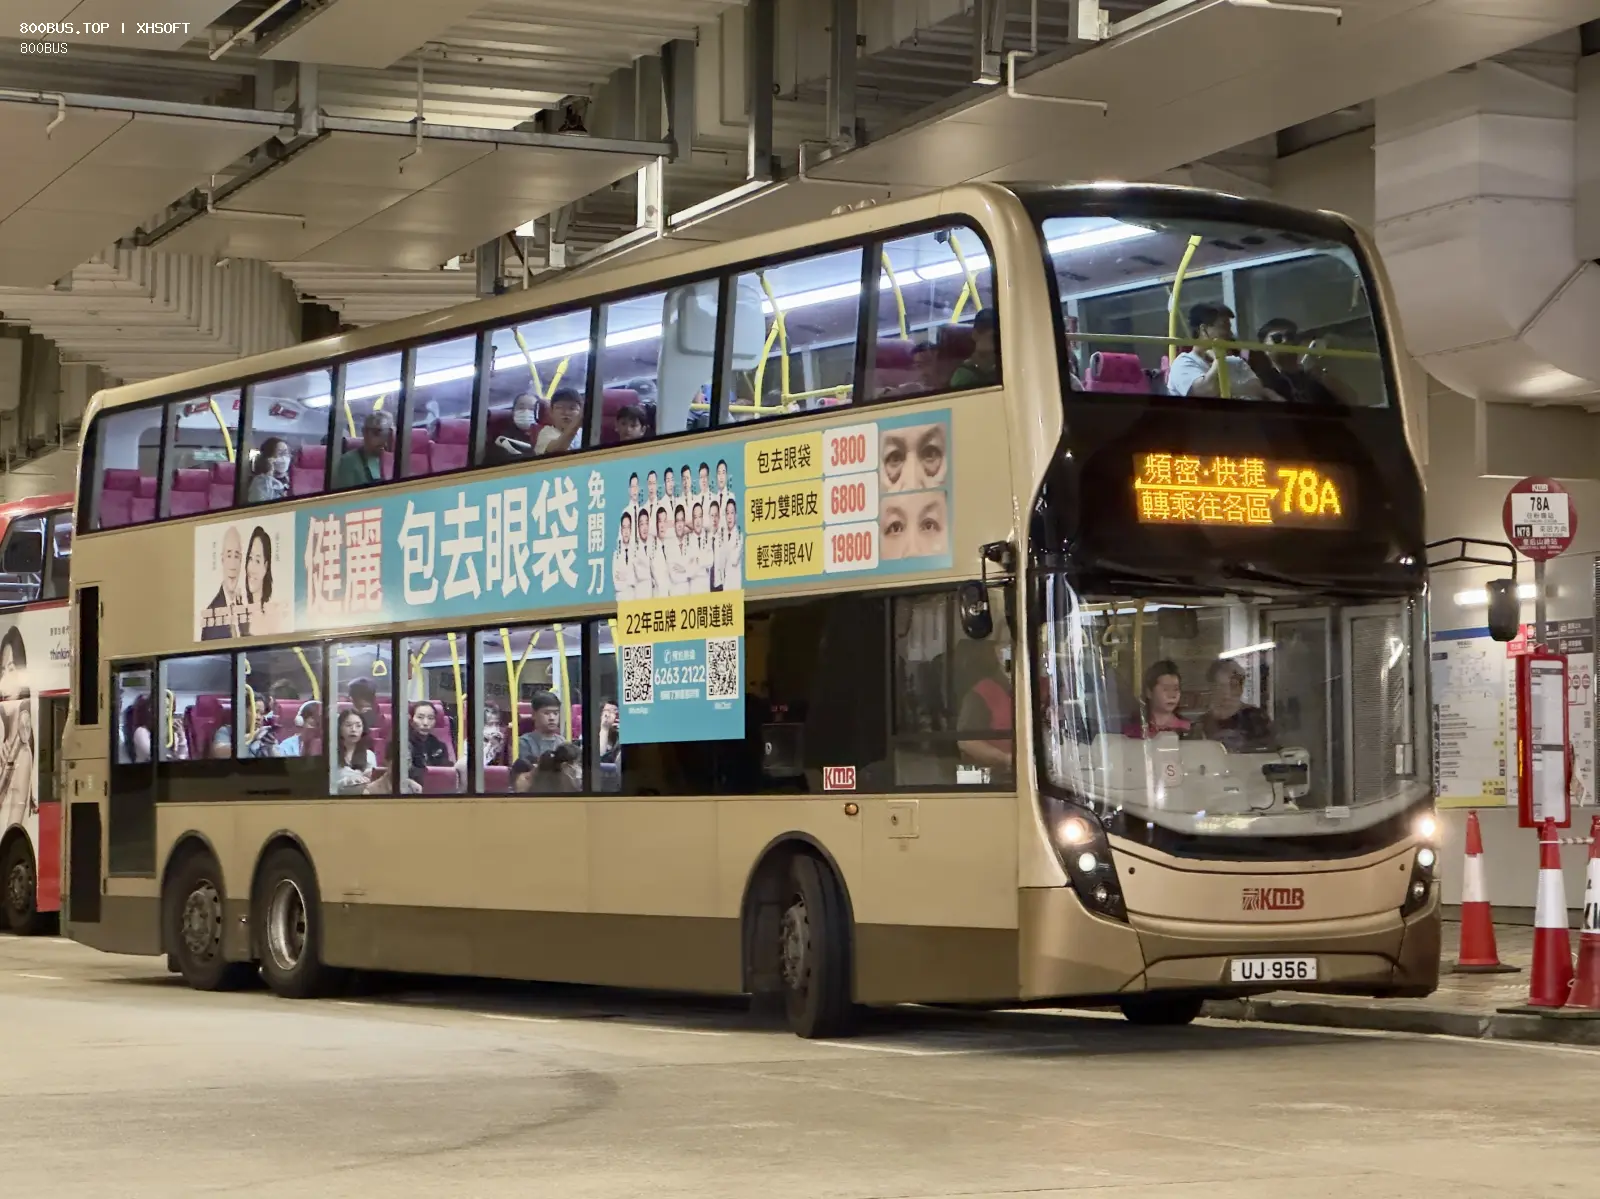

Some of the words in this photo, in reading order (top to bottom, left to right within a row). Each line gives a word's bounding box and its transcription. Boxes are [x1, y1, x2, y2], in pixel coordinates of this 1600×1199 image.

[757, 444, 811, 474] 包去眼袋
[830, 434, 866, 467] 3800
[750, 490, 818, 523] 彈力雙眼皮
[830, 482, 866, 515] 6800
[1277, 467, 1342, 515] 78A
[1530, 496, 1550, 511] 78A
[1141, 490, 1274, 524] 轉乘往各區
[397, 476, 580, 606] 包去眼袋
[587, 470, 606, 595] 免開刀
[831, 531, 872, 563] 19800
[756, 542, 813, 569] 輕薄眼4V
[626, 609, 677, 634] 22年品牌
[680, 603, 734, 630] 20間連鎖
[654, 667, 680, 685] 6263
[681, 665, 706, 683] 2122
[824, 766, 856, 789] KMB
[1260, 887, 1304, 910] KMB
[1241, 961, 1265, 979] UJ
[1271, 961, 1308, 979] 956
